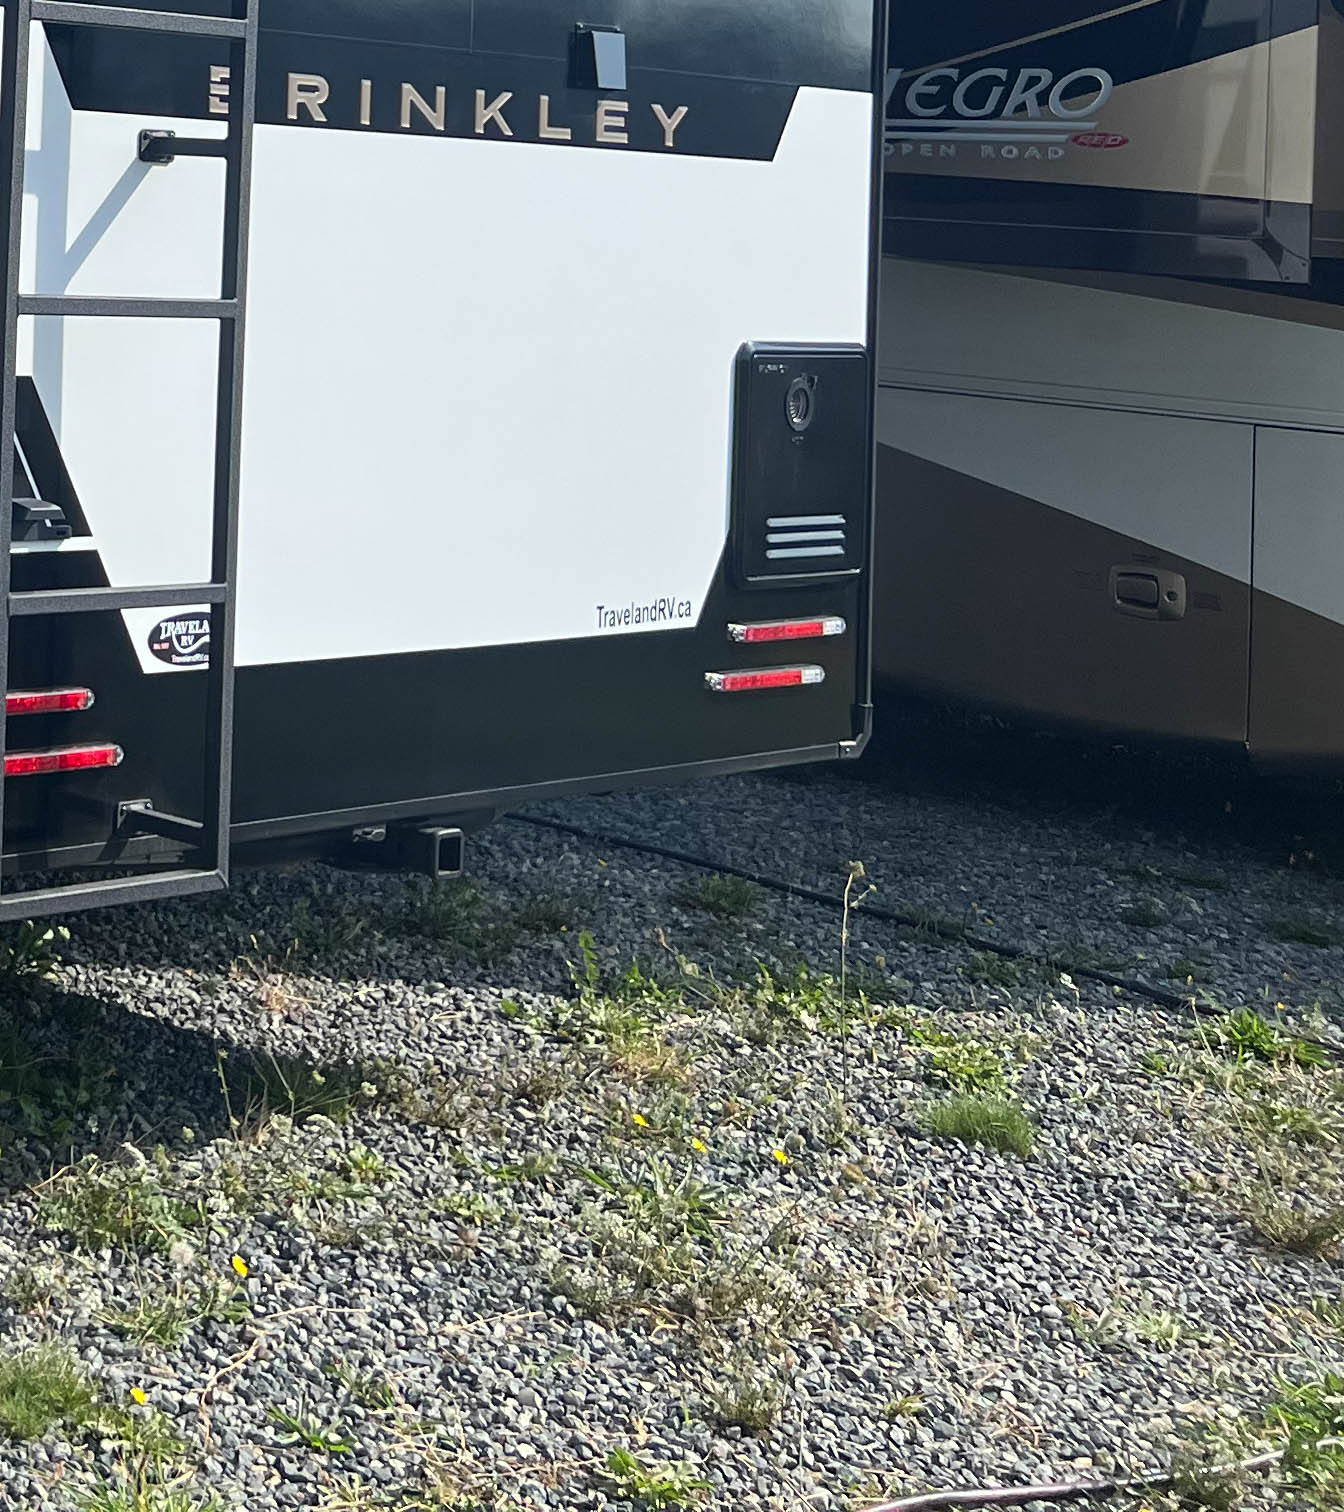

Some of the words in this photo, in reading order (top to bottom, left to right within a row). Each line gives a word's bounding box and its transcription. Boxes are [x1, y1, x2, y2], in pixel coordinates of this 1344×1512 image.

[1076, 135, 1123, 146] RED
[883, 142, 956, 158] OPEN
[980, 144, 1065, 160] ROAD
[596, 595, 692, 629] TravelandRV.ca
[159, 619, 211, 640] TRAVELA
[180, 634, 195, 647] RV
